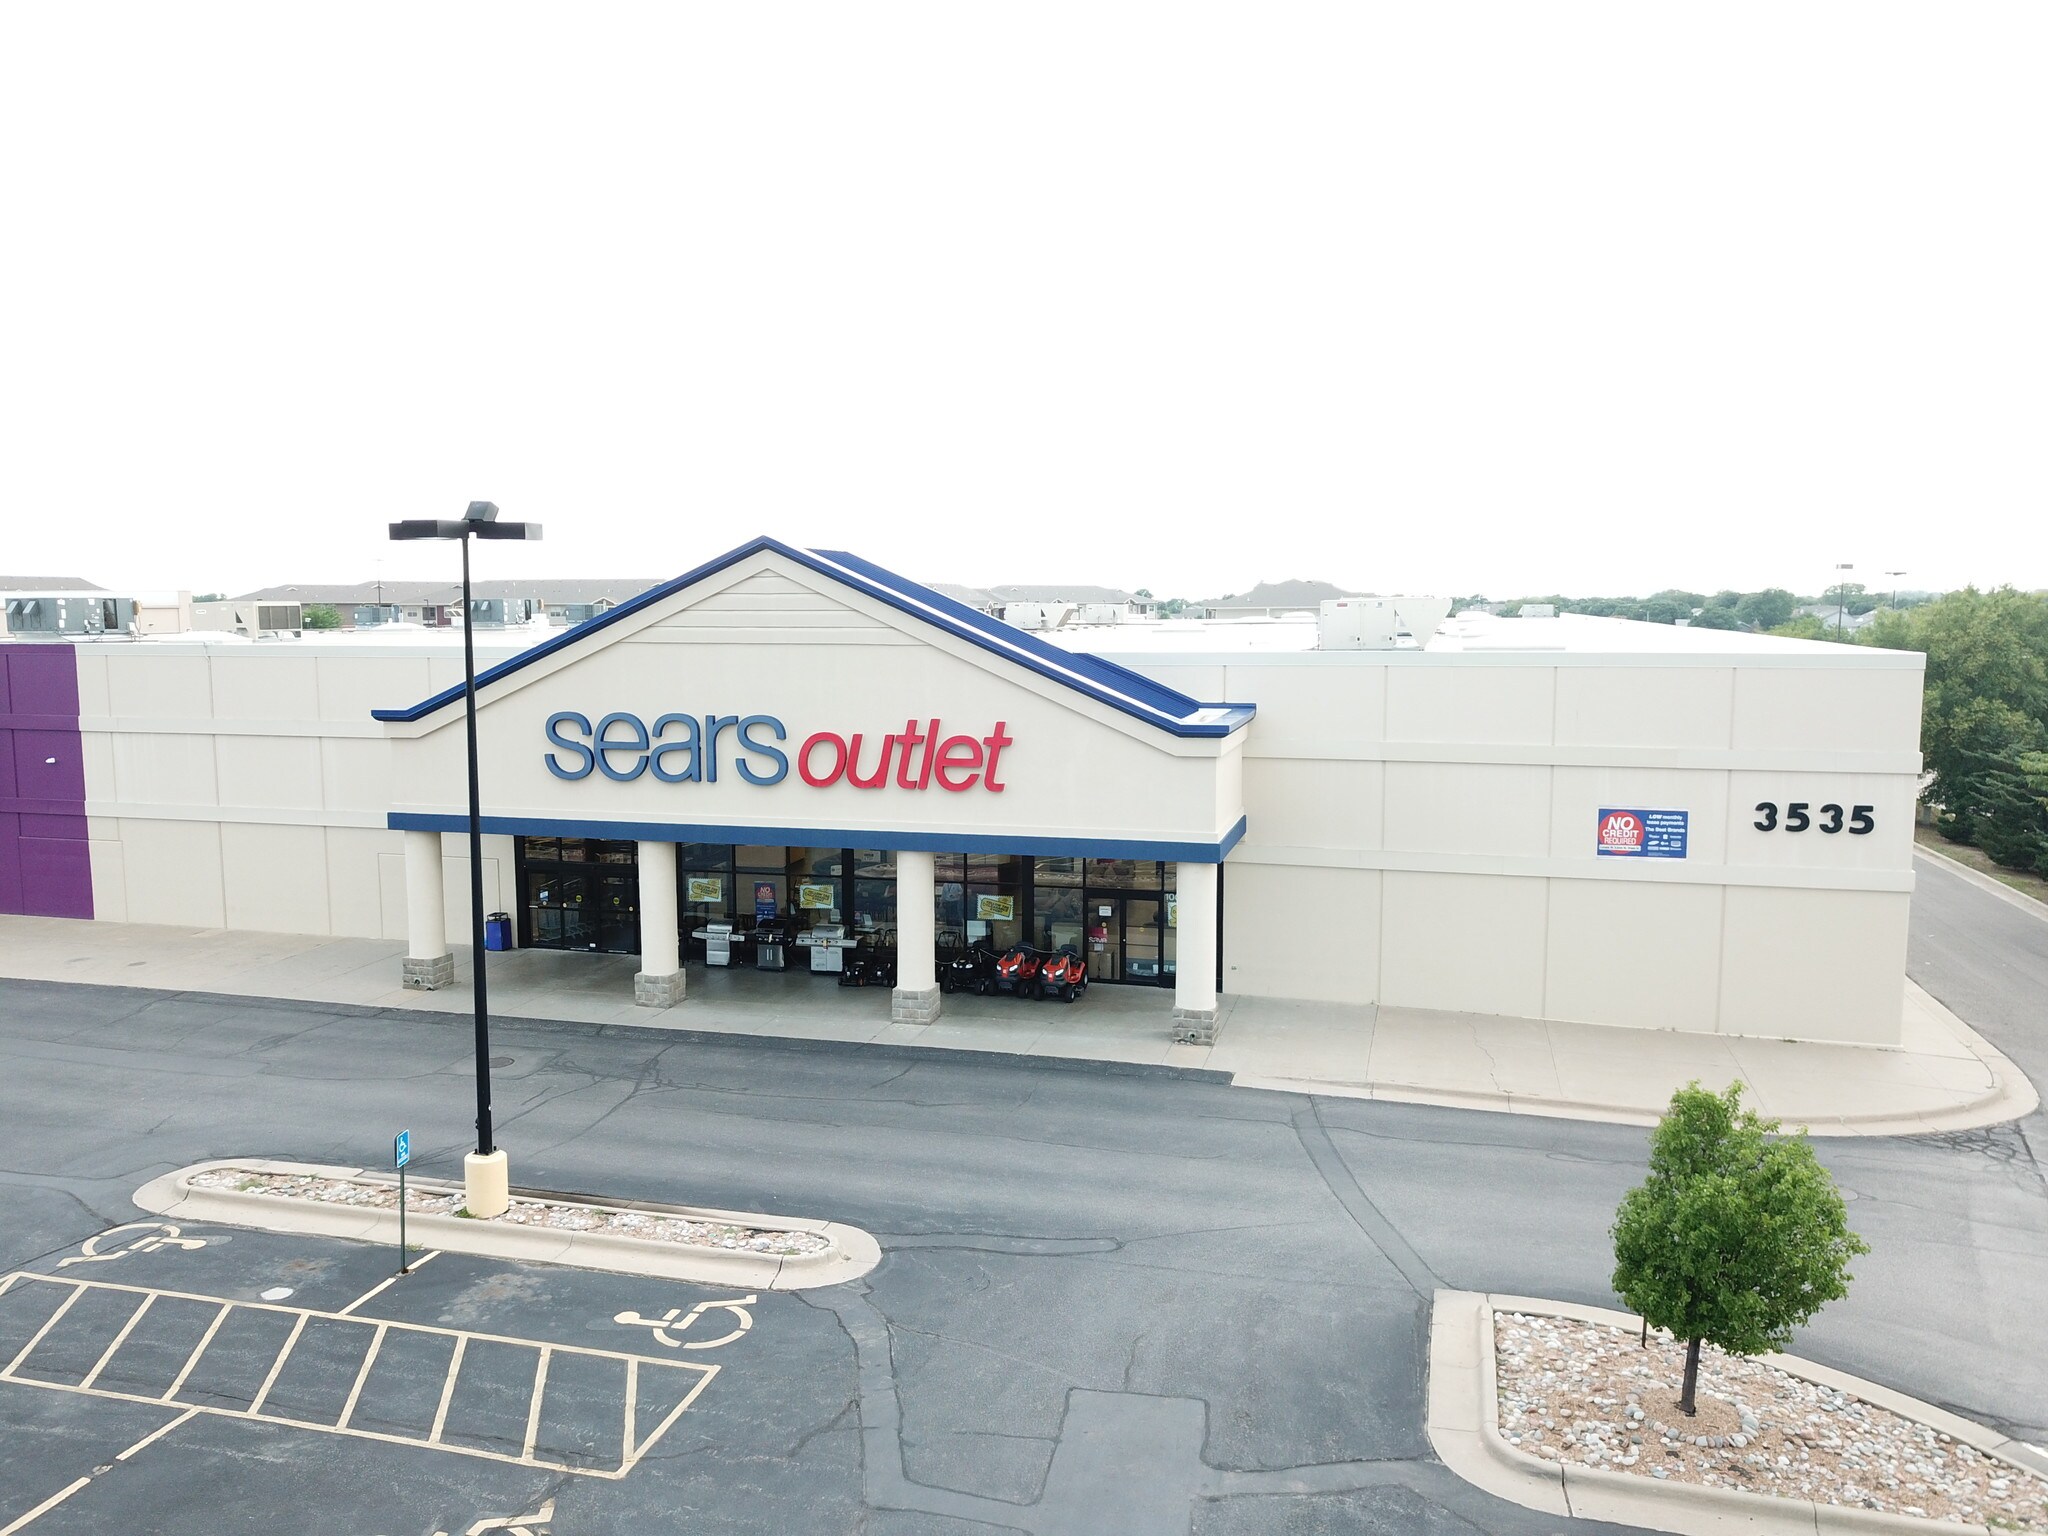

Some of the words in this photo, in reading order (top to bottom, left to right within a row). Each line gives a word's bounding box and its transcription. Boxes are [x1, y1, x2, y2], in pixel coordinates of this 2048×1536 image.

[544, 711, 789, 786] sears
[798, 718, 1013, 793] outlet
[1608, 816, 1635, 830] NO
[1753, 801, 1875, 835] 3535
[1602, 829, 1640, 838] CREDIT
